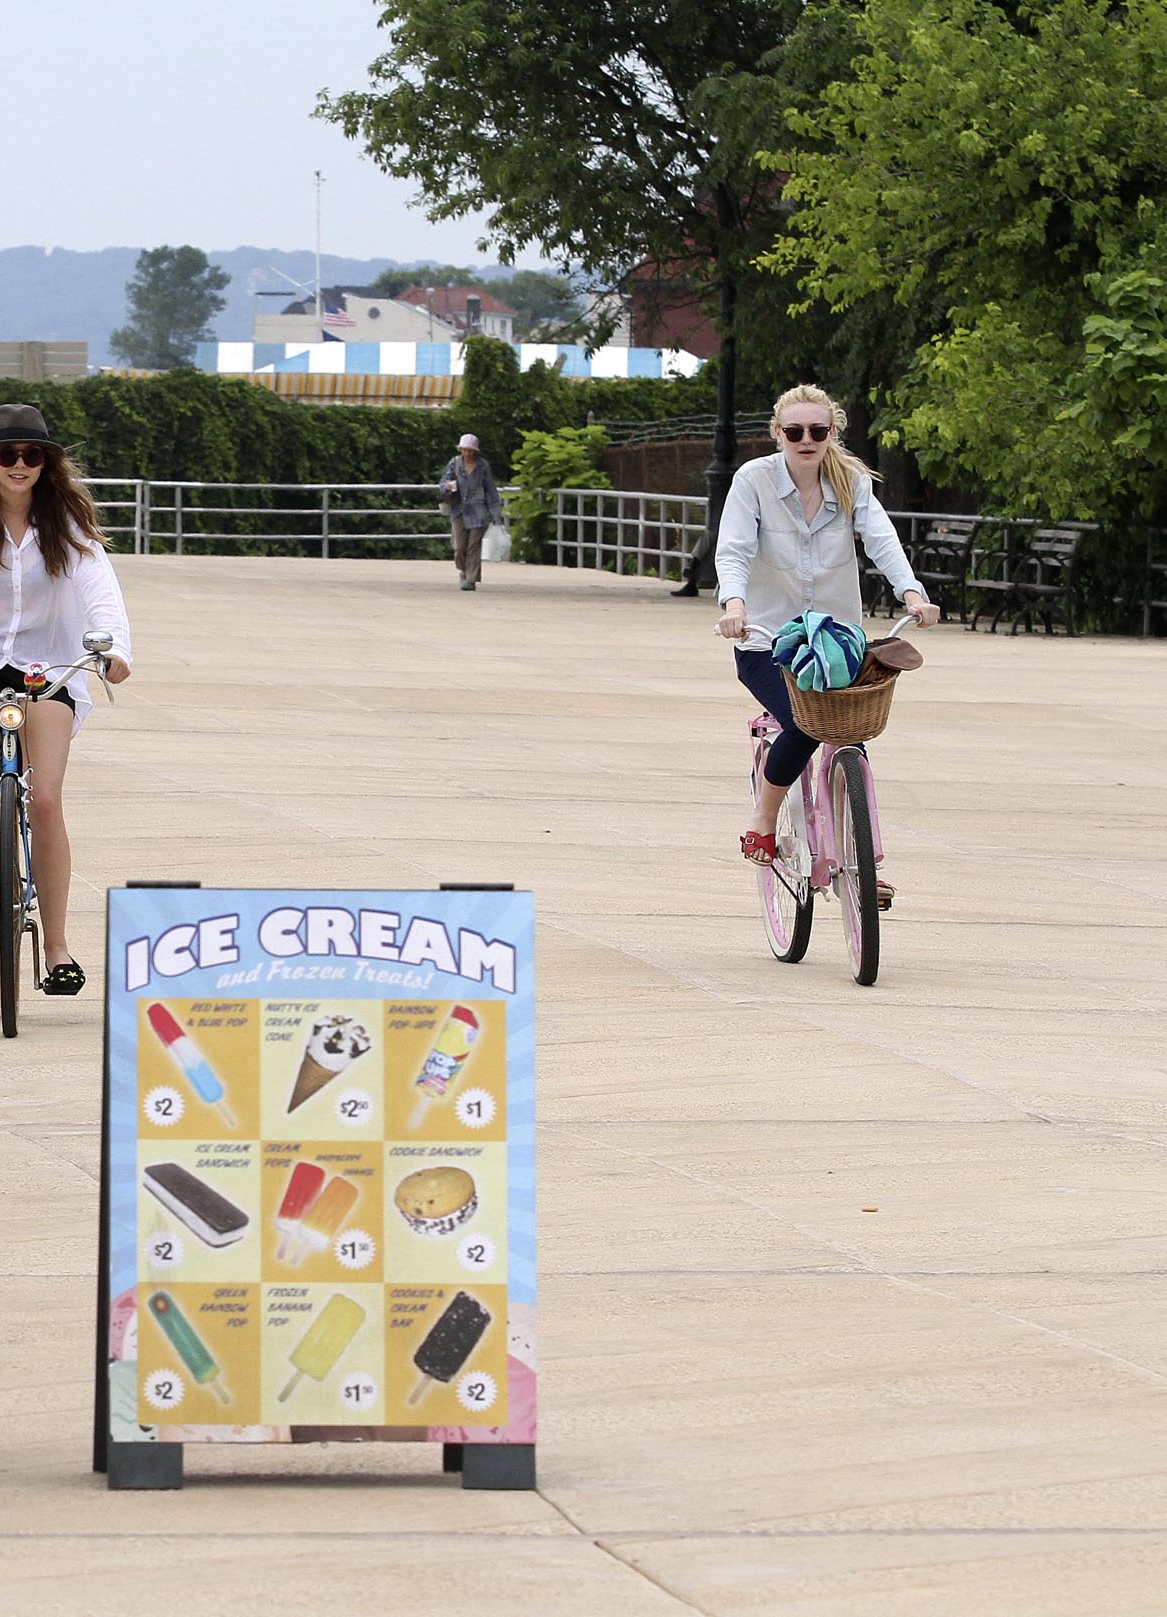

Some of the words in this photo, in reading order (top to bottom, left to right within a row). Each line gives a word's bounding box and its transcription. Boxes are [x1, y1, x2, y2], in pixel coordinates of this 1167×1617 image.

[126, 913, 240, 992] ICE
[258, 907, 516, 994] CREAM
[217, 962, 263, 989] and
[266, 960, 346, 981] Frozen
[353, 961, 433, 989] Treats!
[191, 1003, 211, 1012] RED
[213, 1003, 248, 1012] WHITE
[265, 1003, 302, 1012] NUTTY
[303, 1003, 320, 1012] ICE
[388, 1005, 438, 1014] RAINBOW
[197, 1018, 222, 1027] BLUE
[226, 1018, 248, 1026] POP
[265, 1018, 302, 1026] CREAM
[265, 1032, 293, 1041] CONE
[154, 1098, 173, 1116] $2
[466, 1100, 482, 1118] $1
[195, 1144, 212, 1153] ICE
[214, 1144, 251, 1153] CREAM
[265, 1144, 301, 1153] CREAM
[389, 1147, 426, 1156] COOKIE
[428, 1148, 483, 1157] SANDWICH
[196, 1159, 252, 1168] SANDWICH
[154, 1242, 173, 1260] $2
[466, 1244, 485, 1263] $2
[268, 1288, 309, 1297] FROZEN
[200, 1303, 250, 1312] RAINBOW
[268, 1303, 313, 1312] BANANA
[390, 1304, 428, 1312] CREAM
[226, 1318, 248, 1327] POP
[268, 1318, 290, 1327] POP
[390, 1318, 414, 1328] BAR
[155, 1381, 173, 1399] $2
[467, 1383, 485, 1401] $2
